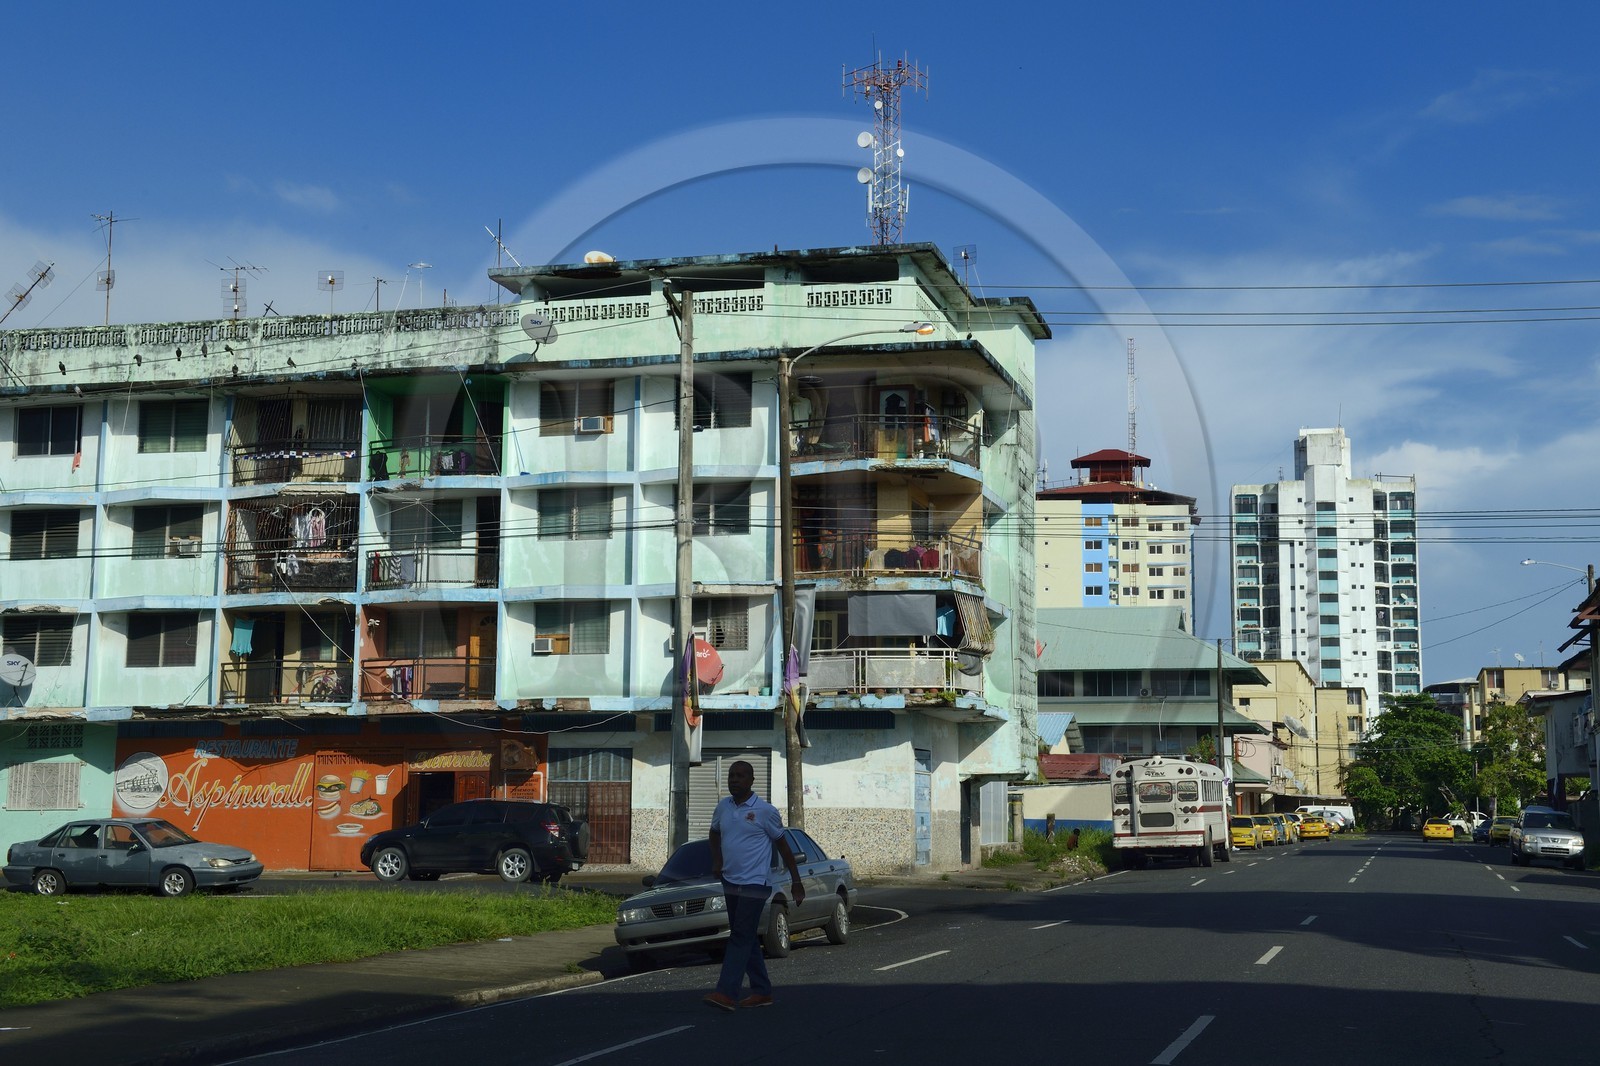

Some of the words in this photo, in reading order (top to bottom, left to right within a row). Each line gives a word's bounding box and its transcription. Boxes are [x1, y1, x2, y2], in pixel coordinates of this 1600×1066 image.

[193, 738, 299, 758] RESTAURANTE
[408, 750, 493, 770] Bienvenidos
[158, 757, 313, 831] Aspinwall
